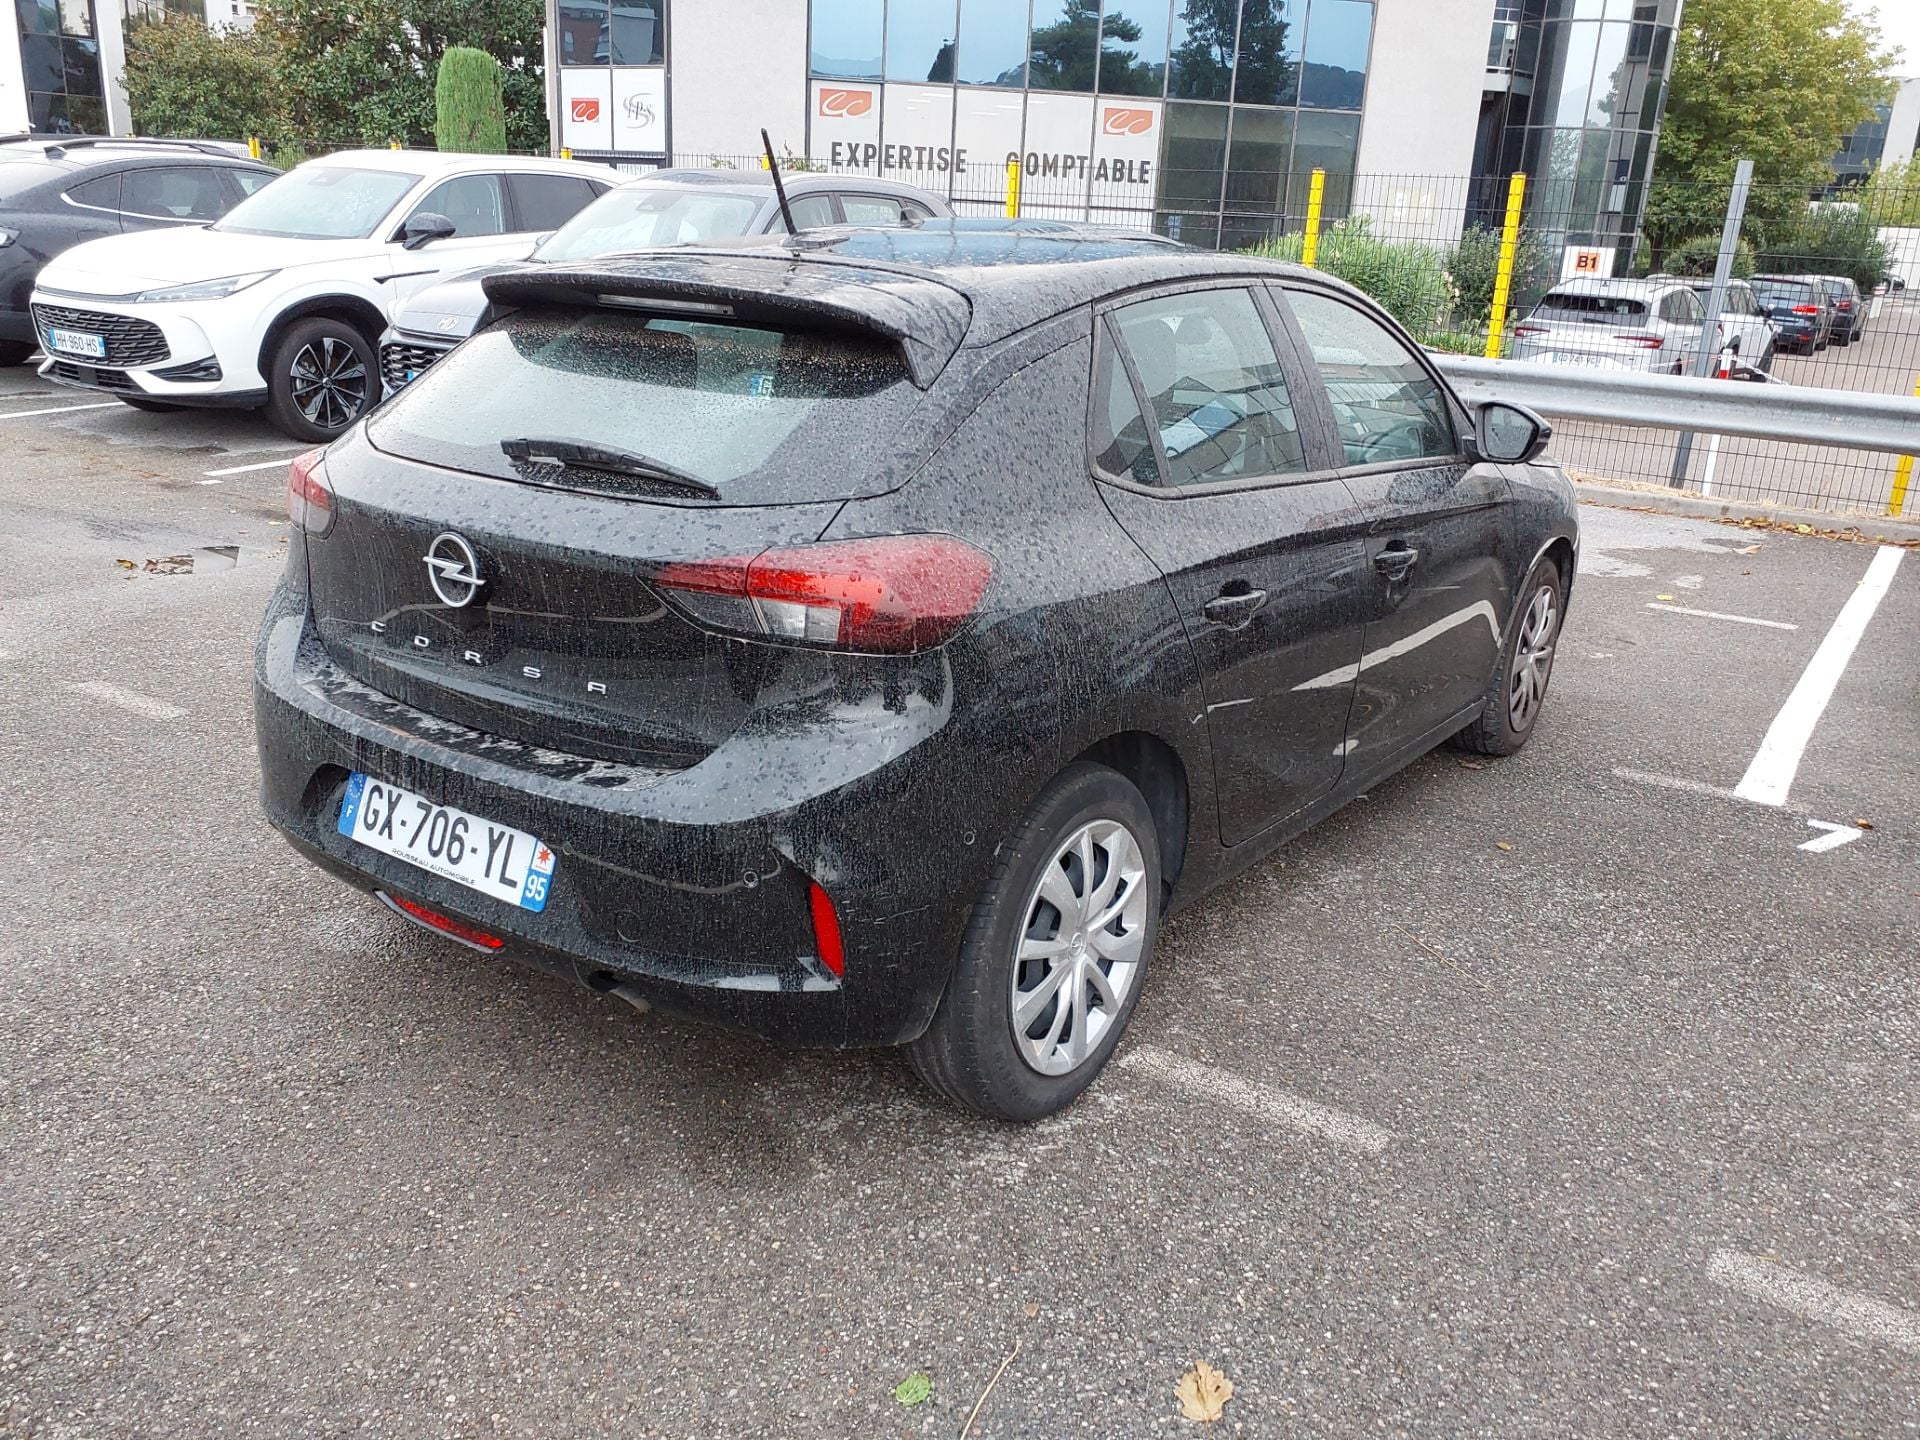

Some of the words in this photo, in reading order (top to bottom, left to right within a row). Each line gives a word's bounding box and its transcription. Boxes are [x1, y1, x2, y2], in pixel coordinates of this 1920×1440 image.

[832, 142, 967, 173] EXPERTISE
[1577, 255, 1597, 268] B1
[371, 620, 607, 695] CORSA
[345, 804, 354, 818] F
[363, 784, 518, 889] GX-706-YL
[392, 847, 429, 867] ROUSSEAU
[430, 863, 476, 886] AUTOMOBILE
[525, 874, 548, 899] 95
